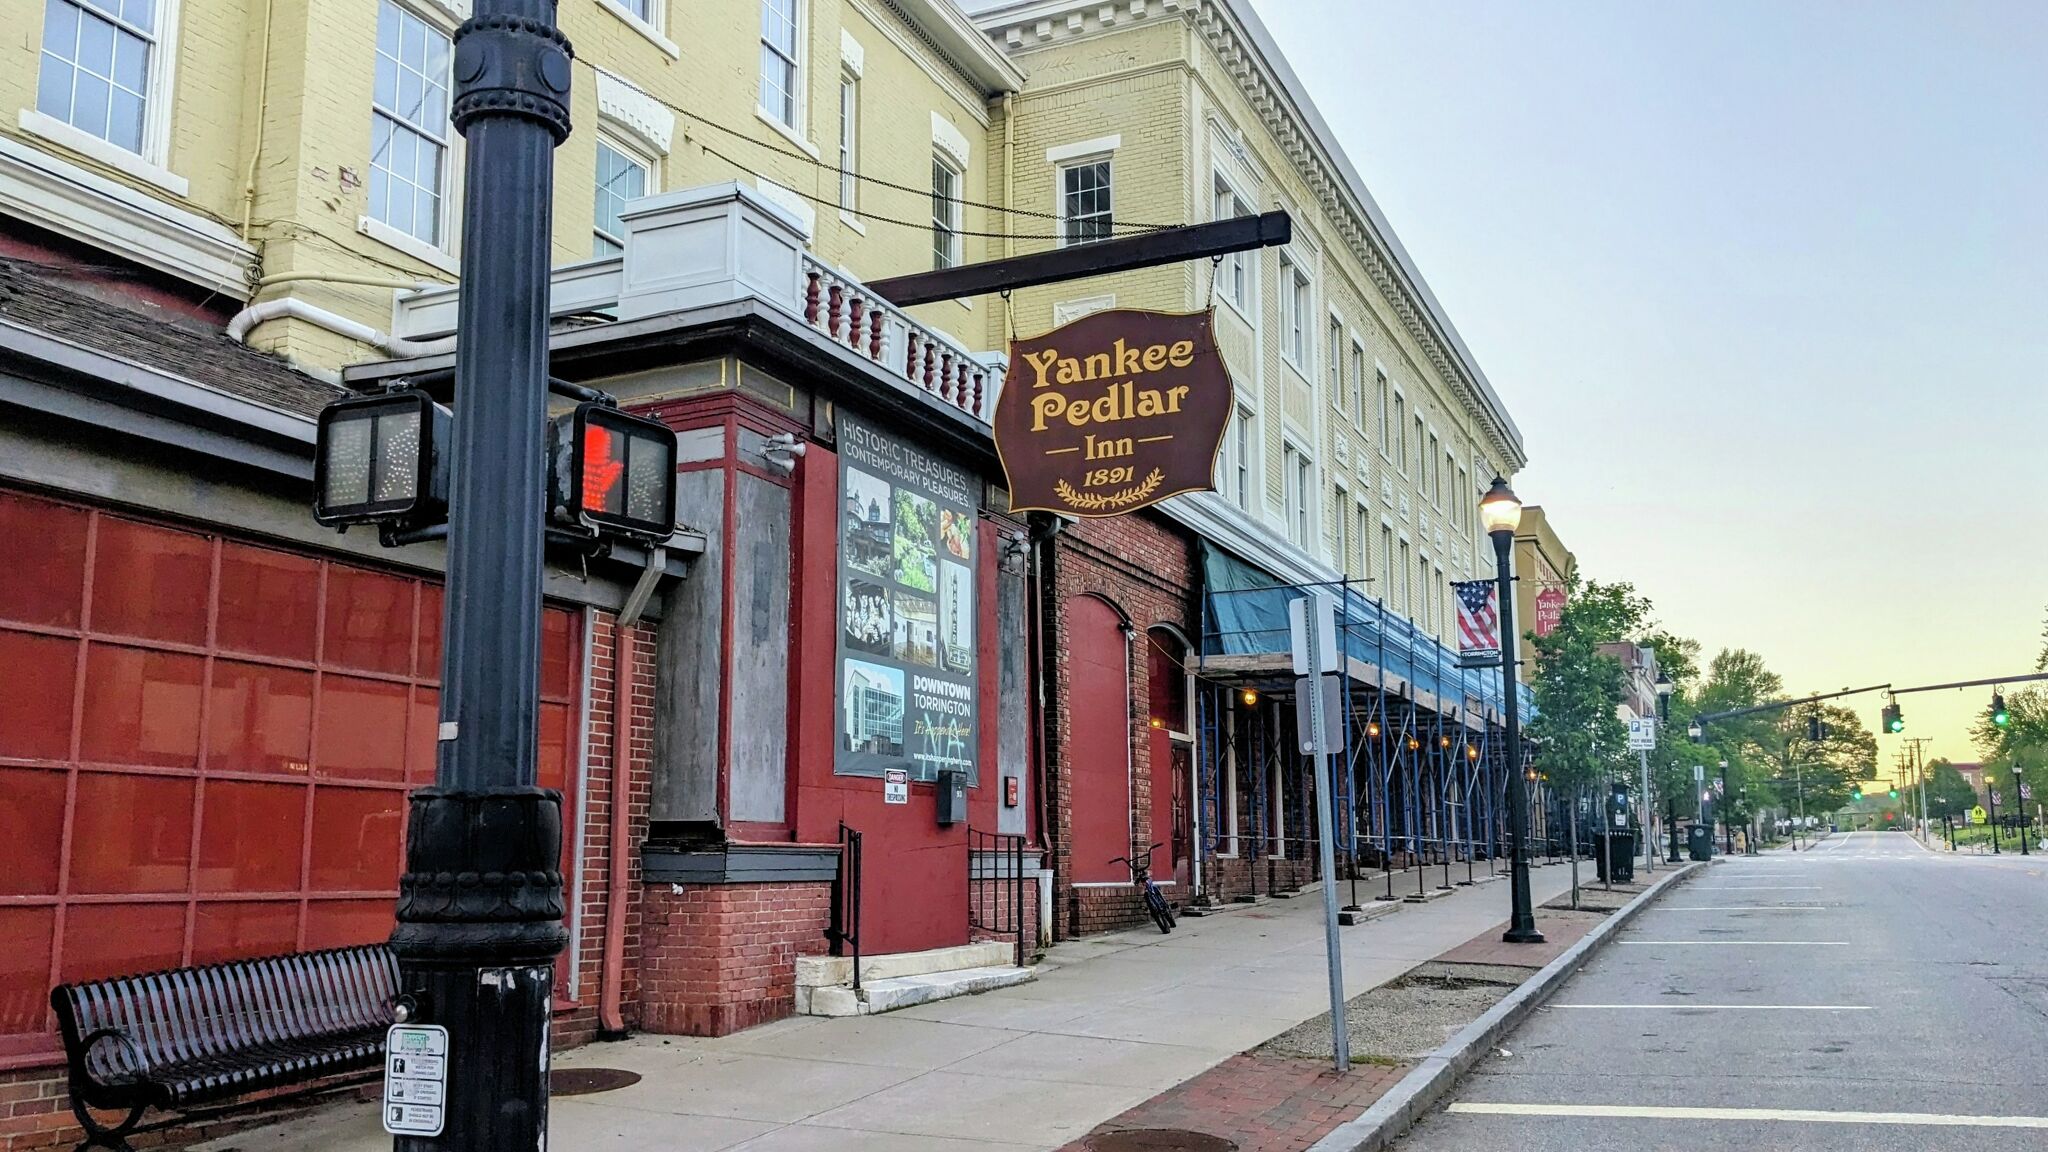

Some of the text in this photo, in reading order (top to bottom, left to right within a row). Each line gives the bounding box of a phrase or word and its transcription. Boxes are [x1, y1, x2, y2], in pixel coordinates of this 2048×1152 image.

[1022, 338, 1195, 389] Yankee
[1030, 380, 1190, 432] Pedlar
[842, 418, 970, 496] HISTORIC TREASURES,
[1084, 434, 1134, 461] Inn
[845, 441, 971, 509] CONTEMPORARY PLEASURES.
[1083, 466, 1134, 487] 1891
[1538, 610, 1561, 621] Pedla
[913, 674, 971, 701] DOWNTOWN
[913, 693, 971, 718] TORRINGTON
